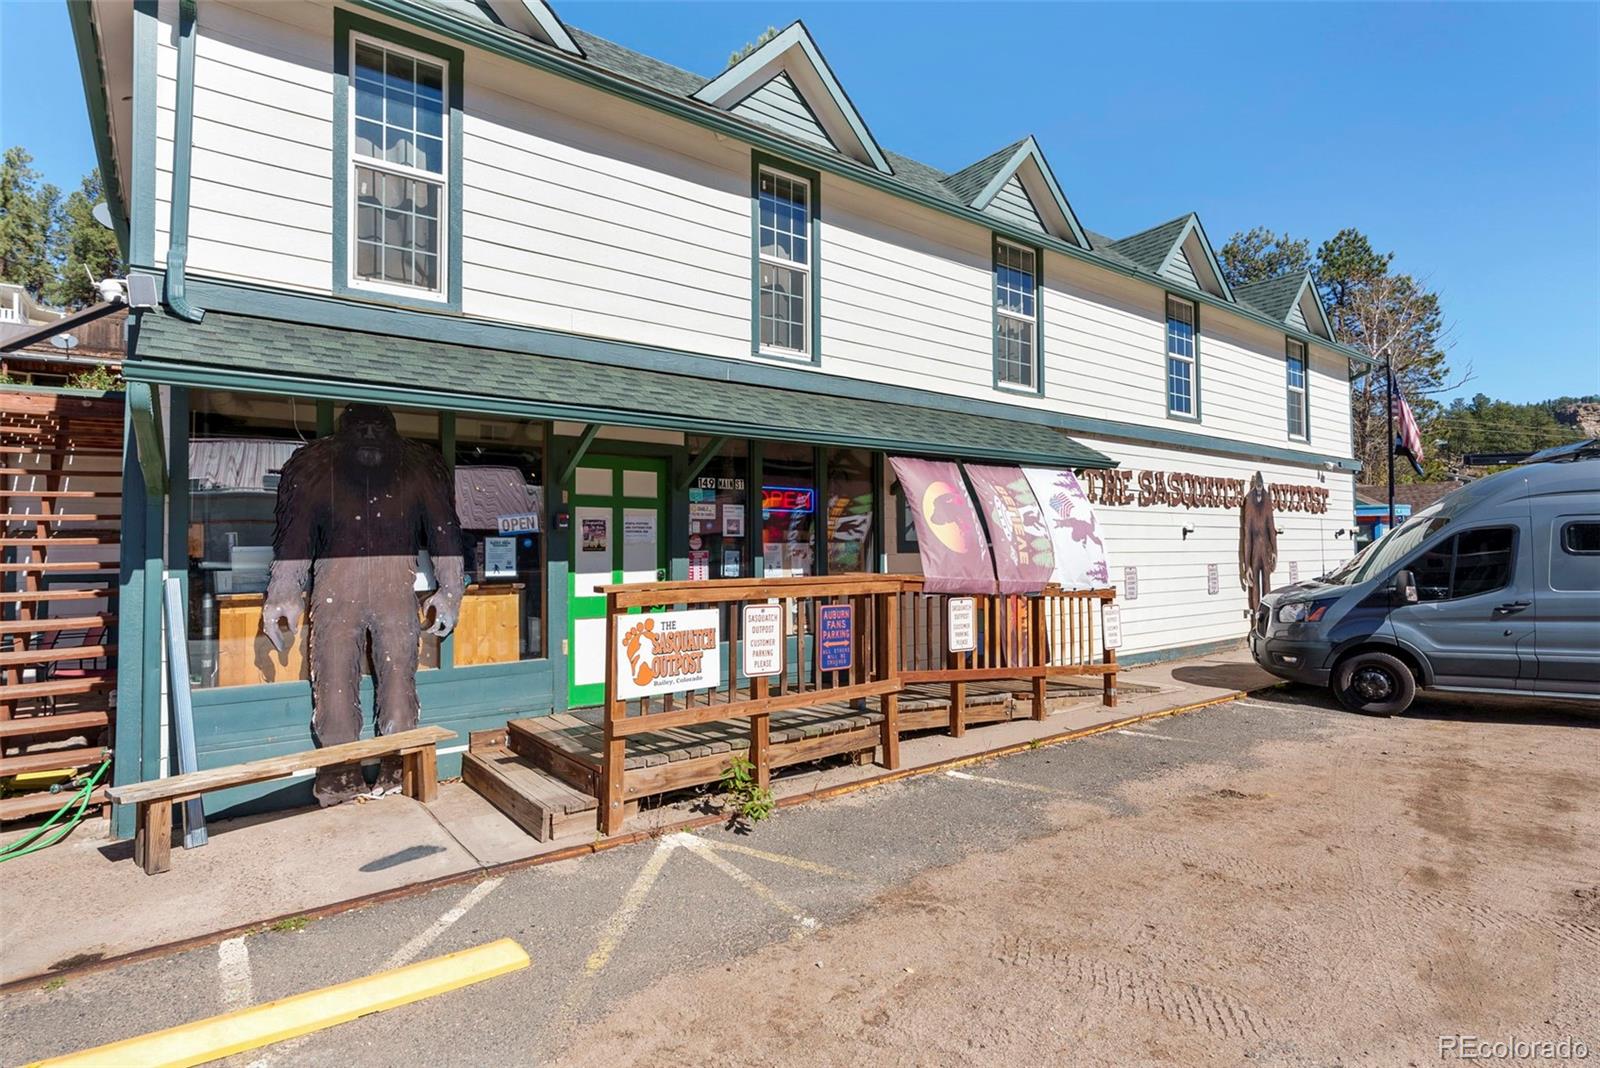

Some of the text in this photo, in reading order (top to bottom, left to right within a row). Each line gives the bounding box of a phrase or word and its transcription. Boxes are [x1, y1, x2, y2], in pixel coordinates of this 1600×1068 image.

[699, 478, 744, 489] 149 MAIN ST
[1083, 469, 1330, 514] THE SASQUATCH OUTPOST
[502, 516, 535, 531] OPEN
[748, 614, 778, 623] SASQUATCH
[823, 610, 850, 620] AUBURN
[660, 620, 677, 631] THE
[752, 625, 774, 634] OUTPOST
[827, 620, 846, 630] FANS
[823, 630, 850, 640] PARKING
[652, 627, 716, 655] SASQUATCH
[750, 638, 776, 648] CUSTOMER
[752, 649, 774, 658] PARKING
[652, 651, 704, 679] OUTPOST
[754, 660, 772, 669] PLEASE
[676, 675, 703, 684] Colorado
